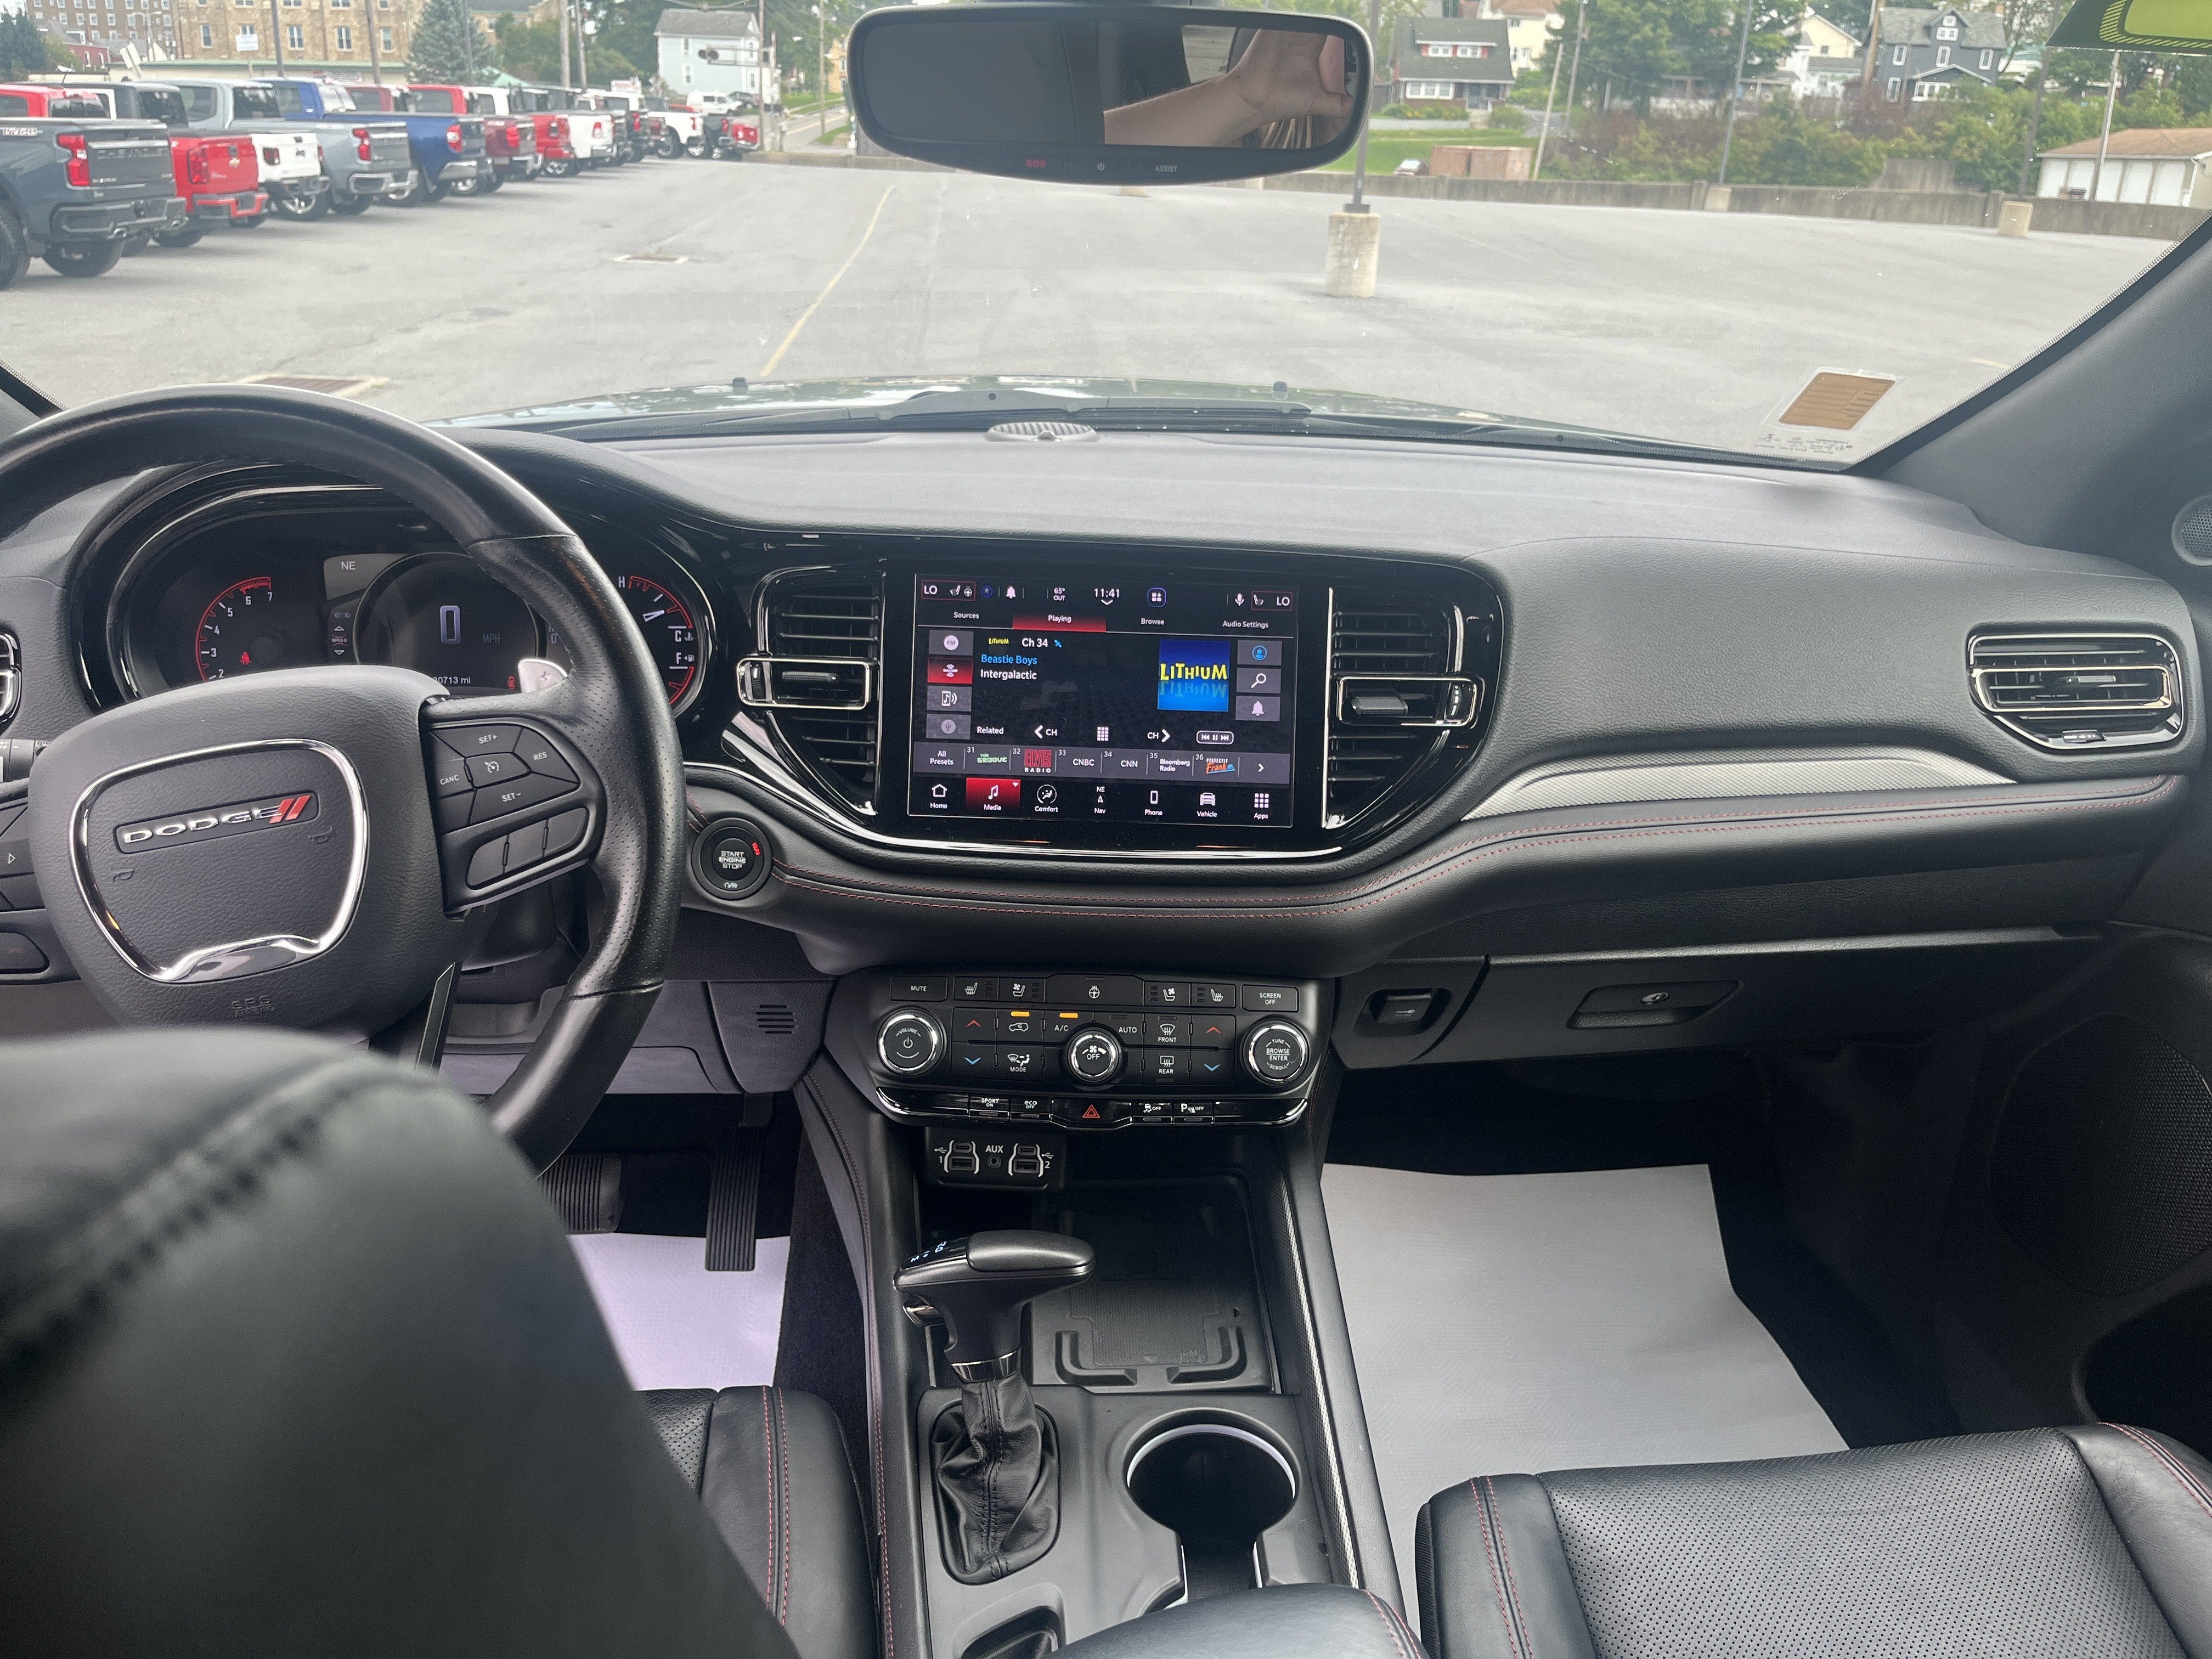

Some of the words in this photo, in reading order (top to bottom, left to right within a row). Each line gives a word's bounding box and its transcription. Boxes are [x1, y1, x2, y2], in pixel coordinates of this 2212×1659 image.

[341, 561, 356, 570] NE
[618, 576, 625, 588] H
[923, 585, 938, 595] LO
[1094, 588, 1120, 598] 11:41
[245, 596, 251, 605] 6
[268, 592, 273, 601] 7
[1276, 597, 1290, 606] LO
[227, 608, 233, 617] 5
[1048, 614, 1072, 623] Playing
[439, 605, 461, 644] 0
[1243, 621, 1269, 629] Settings
[214, 625, 220, 635] 4
[483, 634, 501, 644] MPH
[675, 630, 682, 642] C
[1022, 638, 1035, 647] Ch
[1037, 638, 1048, 647] 34
[211, 648, 217, 657] 3
[676, 652, 682, 664] F
[981, 654, 1014, 664] Beastie
[1015, 655, 1037, 667] Boys
[980, 669, 1037, 681] Intergalactic
[1160, 663, 1228, 681] LITHIUM
[533, 752, 548, 761] RES
[1024, 749, 1052, 768] ELVIS
[440, 774, 460, 785] CANC
[125, 804, 281, 843] DODGE
[1181, 1103, 1188, 1113] P
[985, 1145, 1003, 1153] AUX
